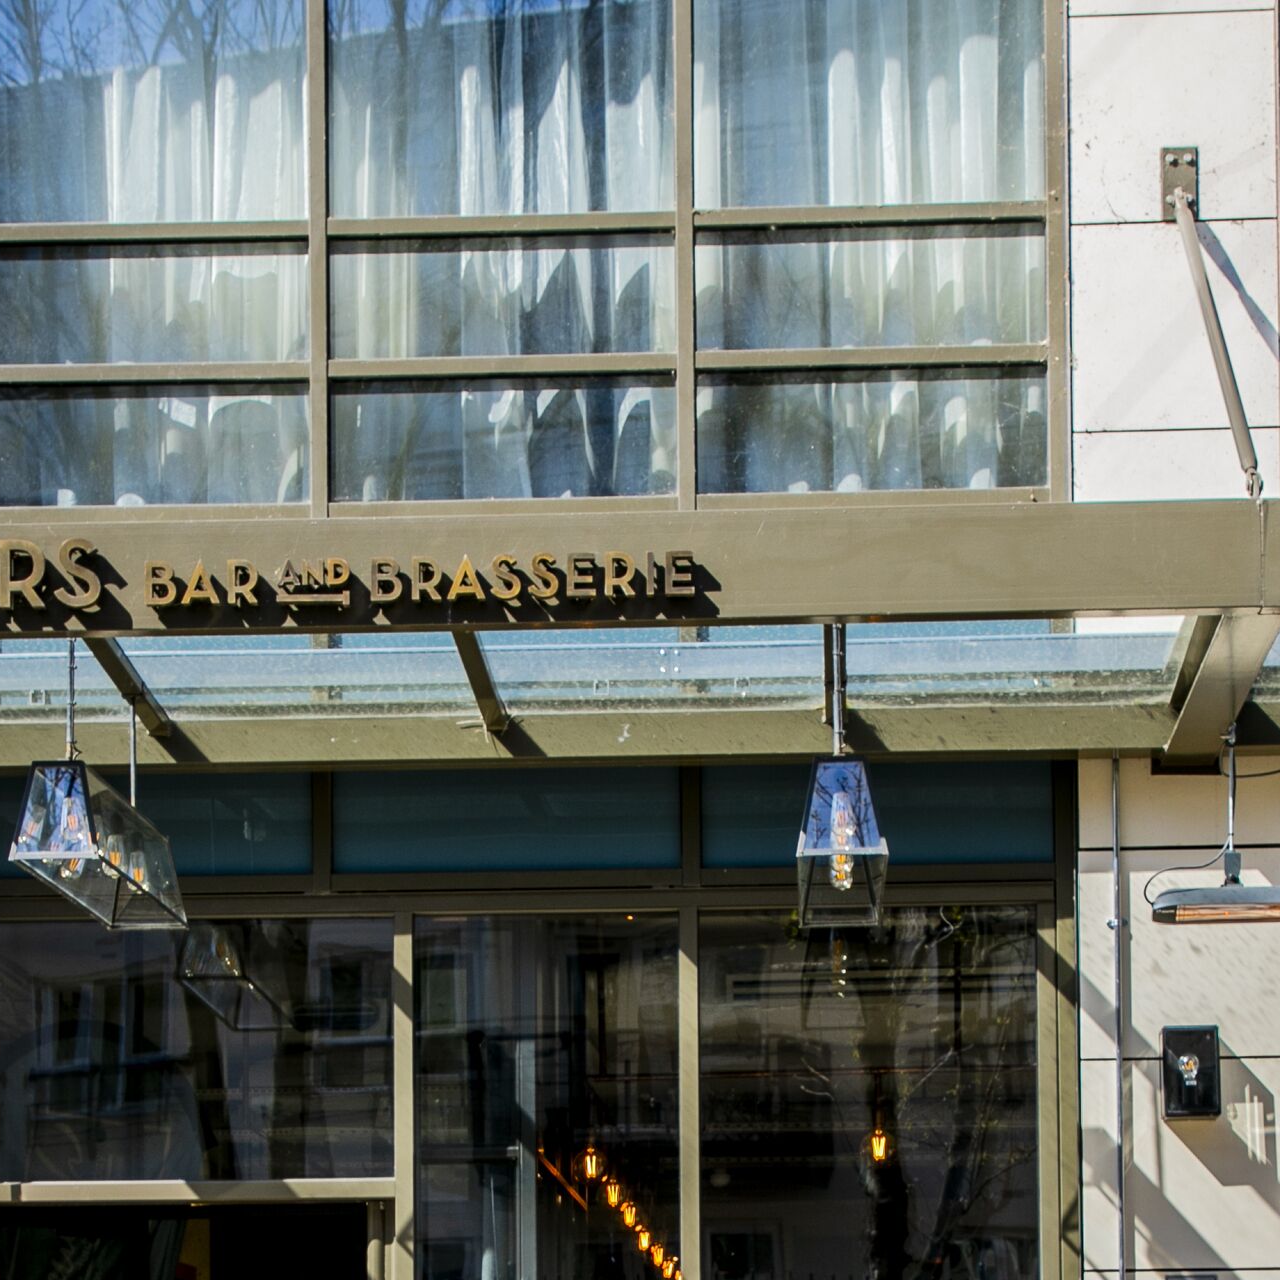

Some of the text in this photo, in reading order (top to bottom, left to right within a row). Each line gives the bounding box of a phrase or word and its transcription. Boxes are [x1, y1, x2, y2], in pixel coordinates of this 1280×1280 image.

[144, 559, 260, 607] BAR
[277, 558, 351, 588] AND
[371, 551, 695, 603] BRASSERIE
